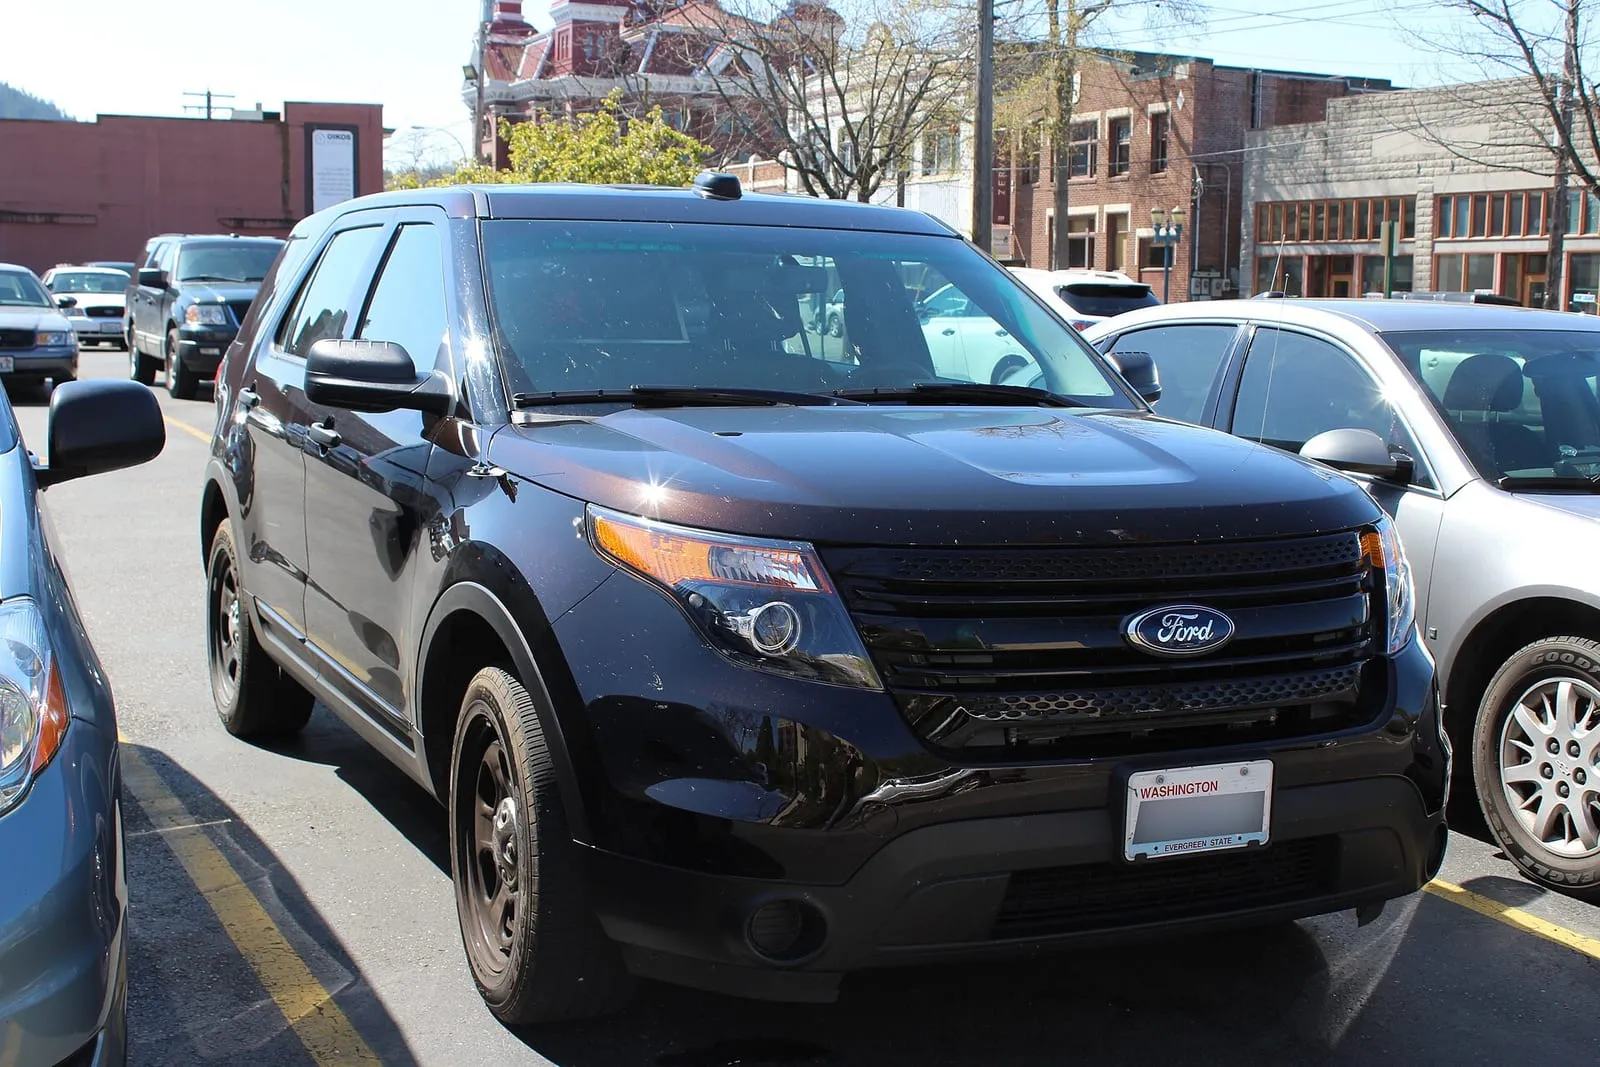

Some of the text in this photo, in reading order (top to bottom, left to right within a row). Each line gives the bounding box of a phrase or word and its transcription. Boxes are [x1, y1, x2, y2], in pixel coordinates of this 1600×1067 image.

[1157, 613, 1214, 643] Ford
[1140, 780, 1219, 800] WASHINGTON
[1164, 837, 1233, 852] EVERGREEN STATE
[1519, 855, 1596, 884] EAGLE
